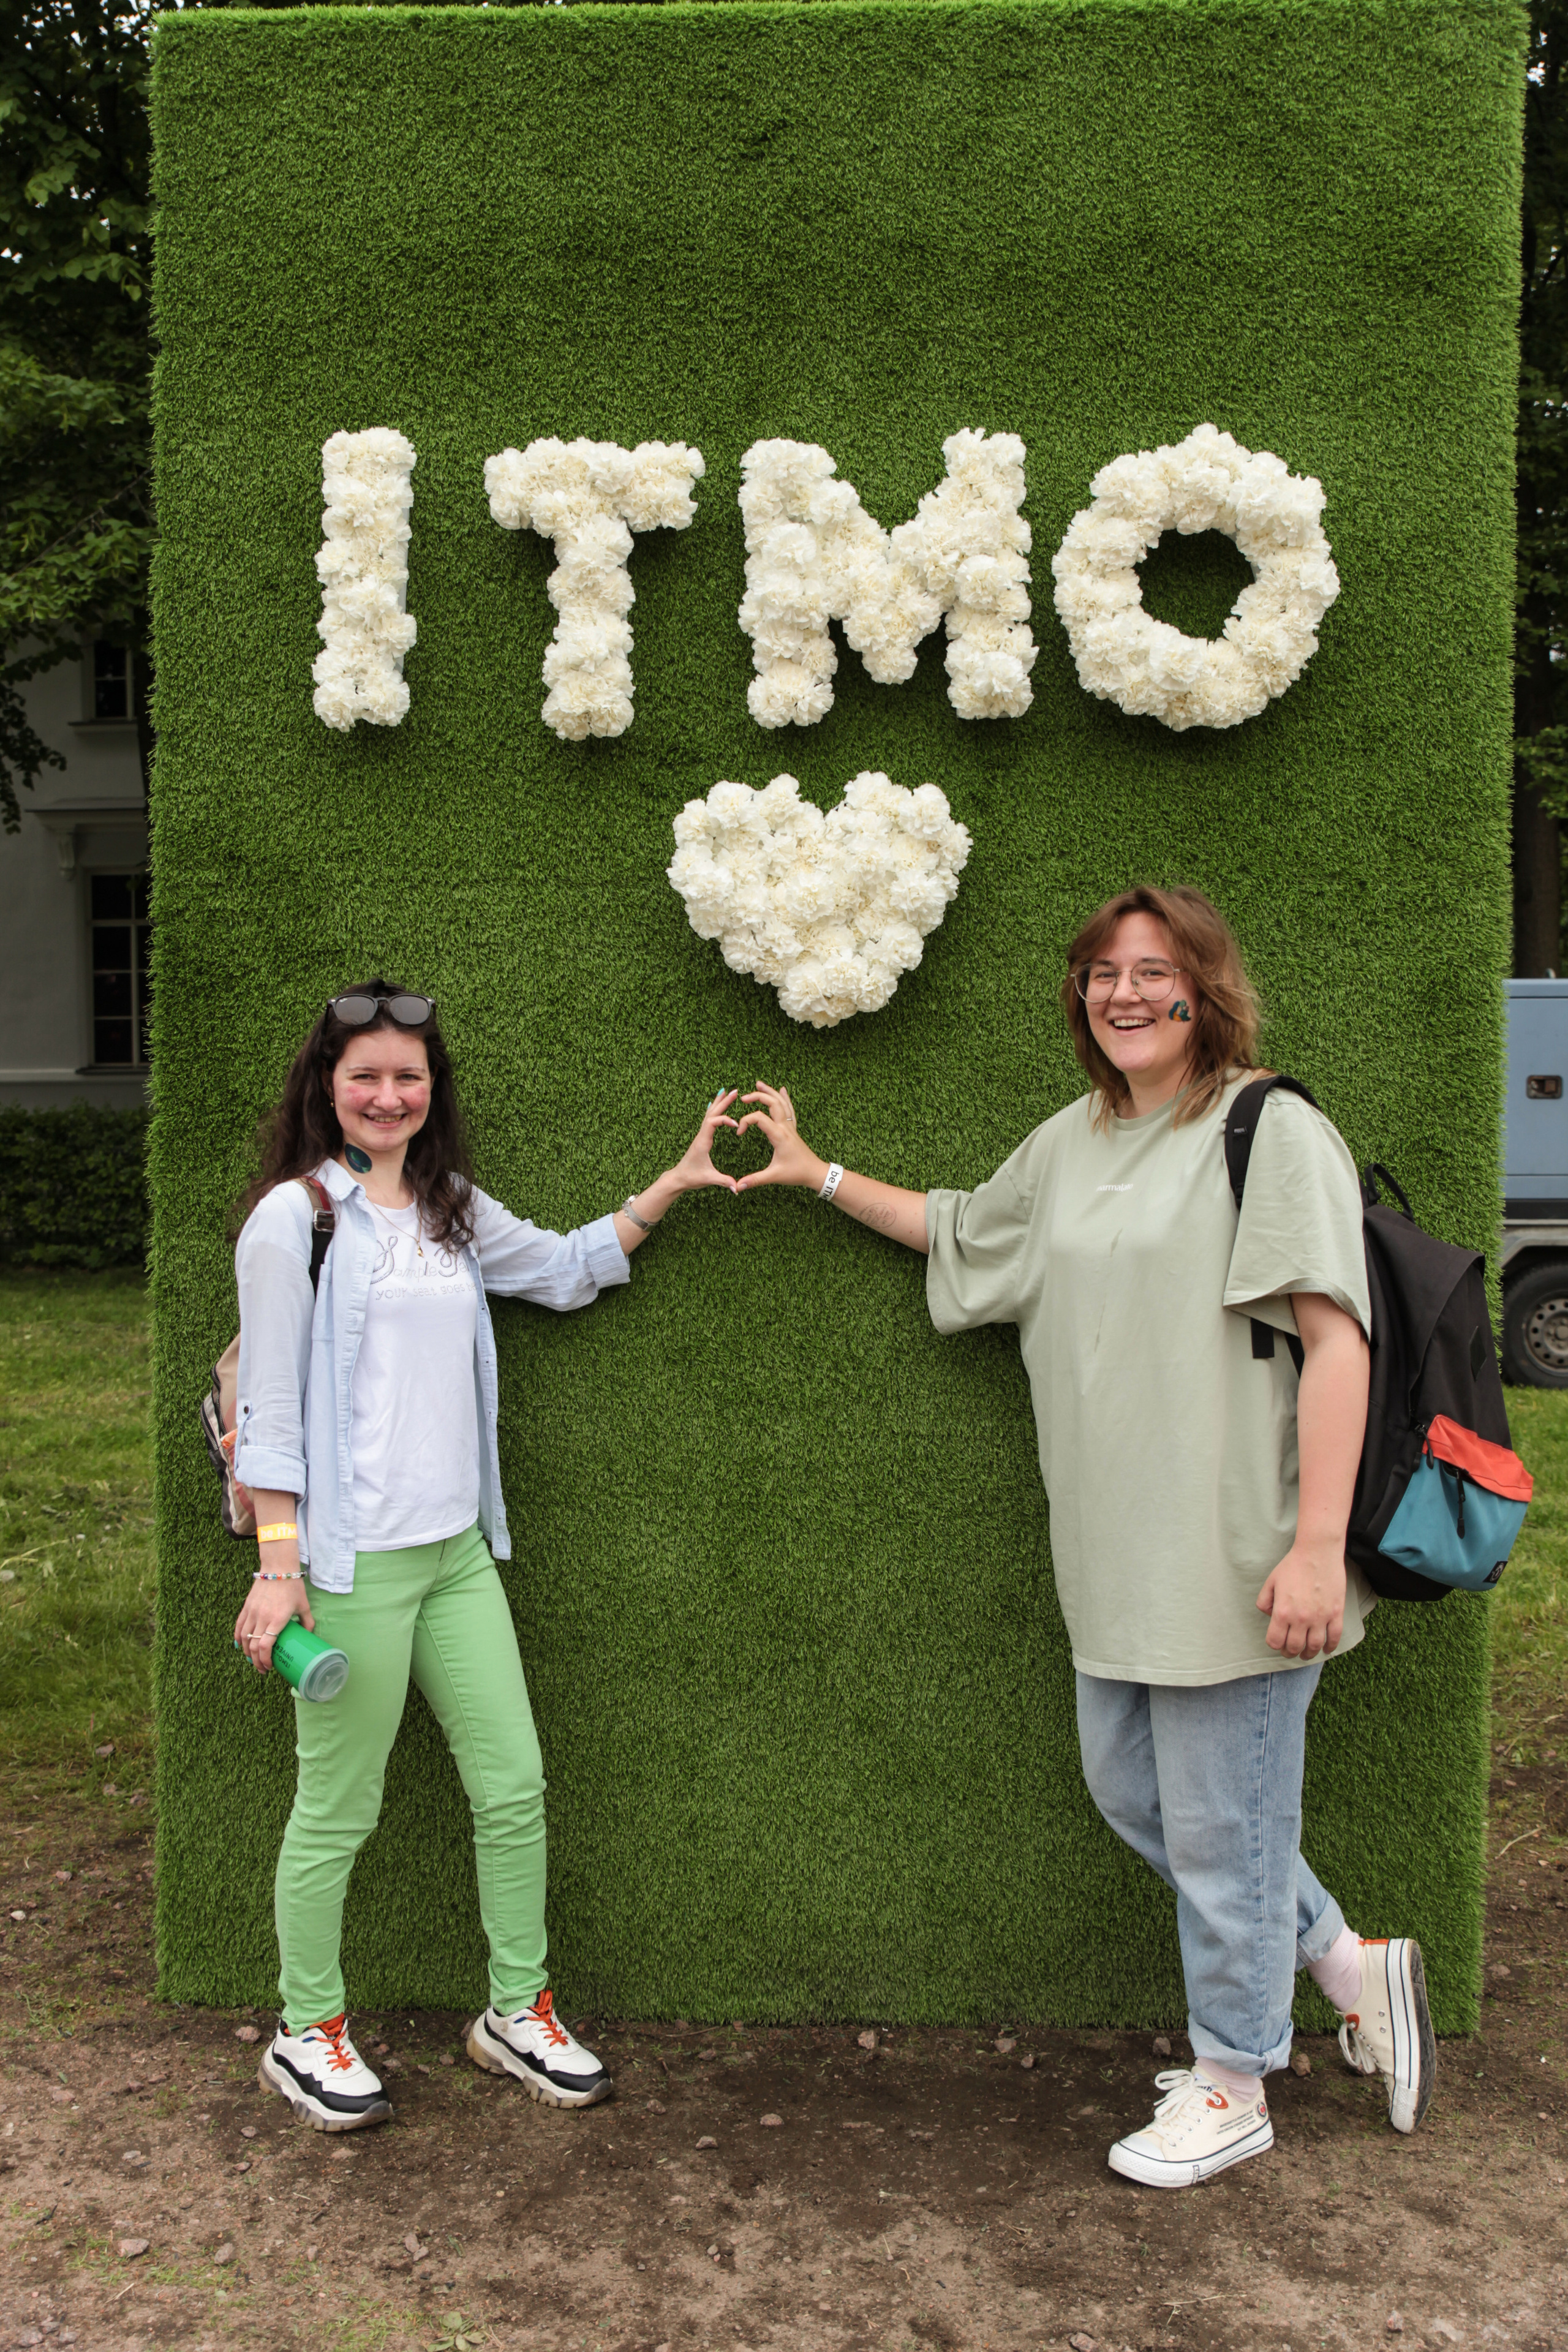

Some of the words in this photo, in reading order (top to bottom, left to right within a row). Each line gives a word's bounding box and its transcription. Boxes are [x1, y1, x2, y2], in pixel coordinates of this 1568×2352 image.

[312, 423, 1340, 742] ITMO
[829, 1170, 839, 1183] be
[260, 1529, 273, 1539] be
